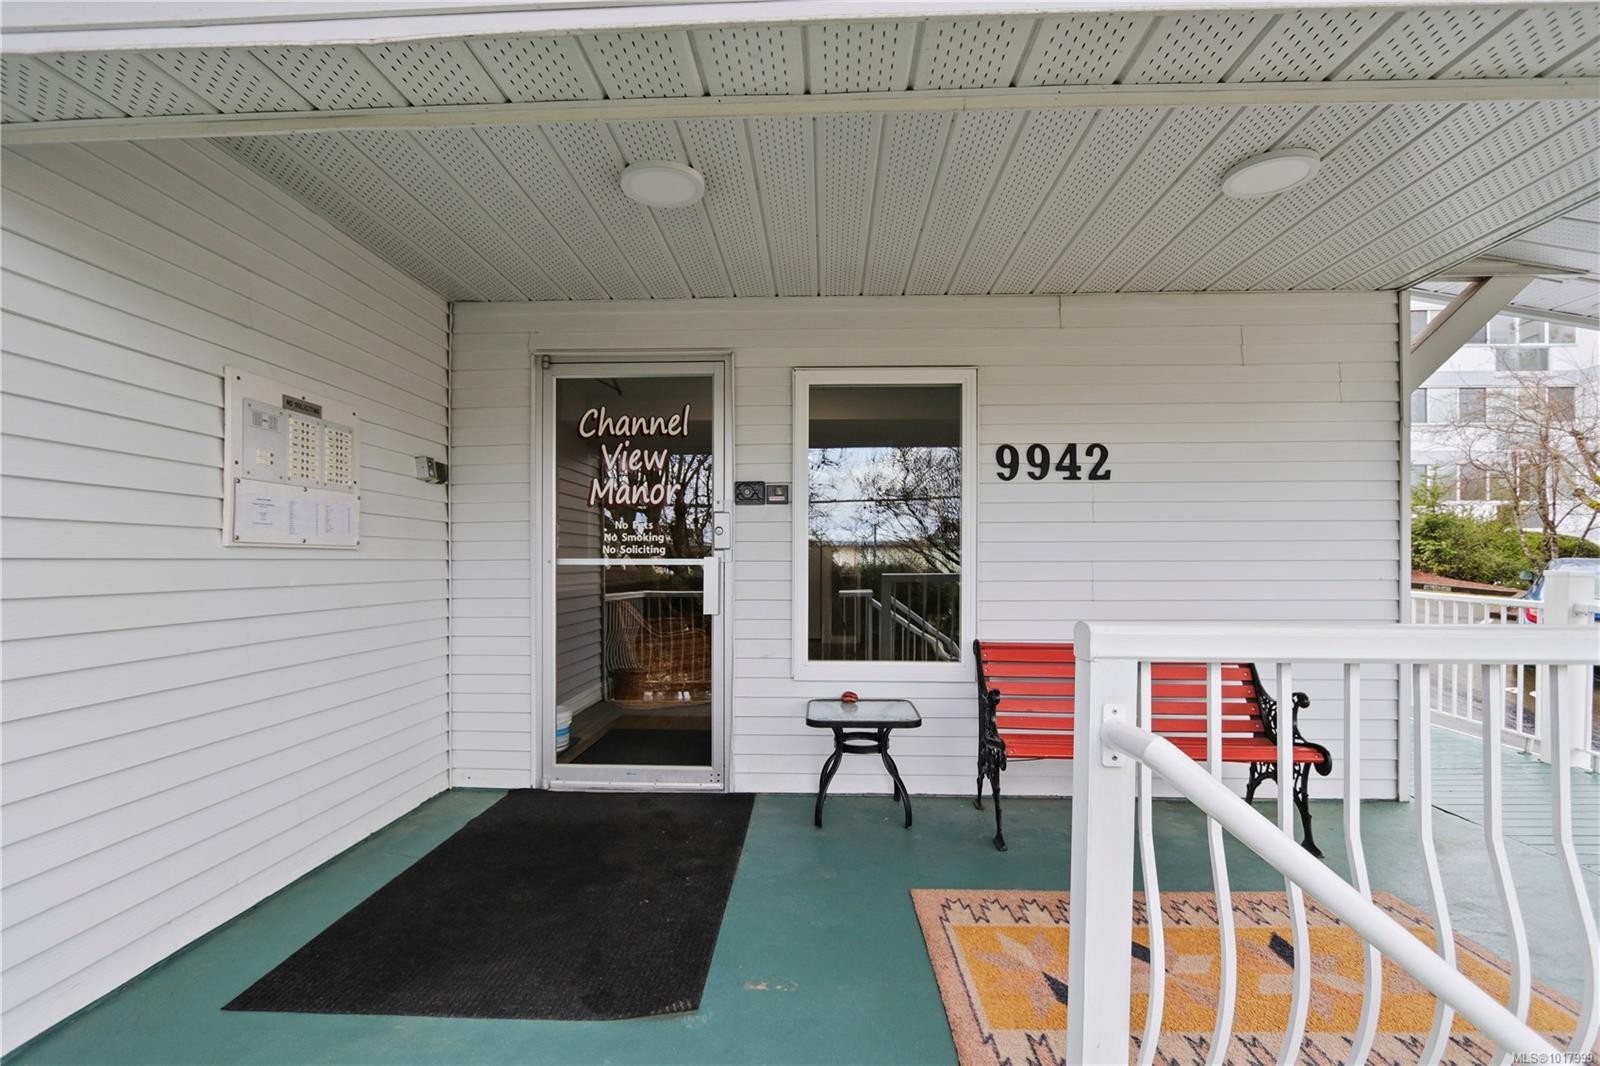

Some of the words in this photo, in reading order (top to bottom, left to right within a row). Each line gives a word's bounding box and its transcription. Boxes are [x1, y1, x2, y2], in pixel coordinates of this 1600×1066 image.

[578, 404, 690, 438] Channel
[601, 440, 668, 471] View
[995, 443, 1111, 481] 9942
[588, 478, 681, 506] Manor
[603, 532, 618, 542] No
[621, 532, 665, 544] Smoking
[614, 520, 629, 530] No
[602, 545, 616, 554] No
[620, 545, 666, 556] Soliciting
